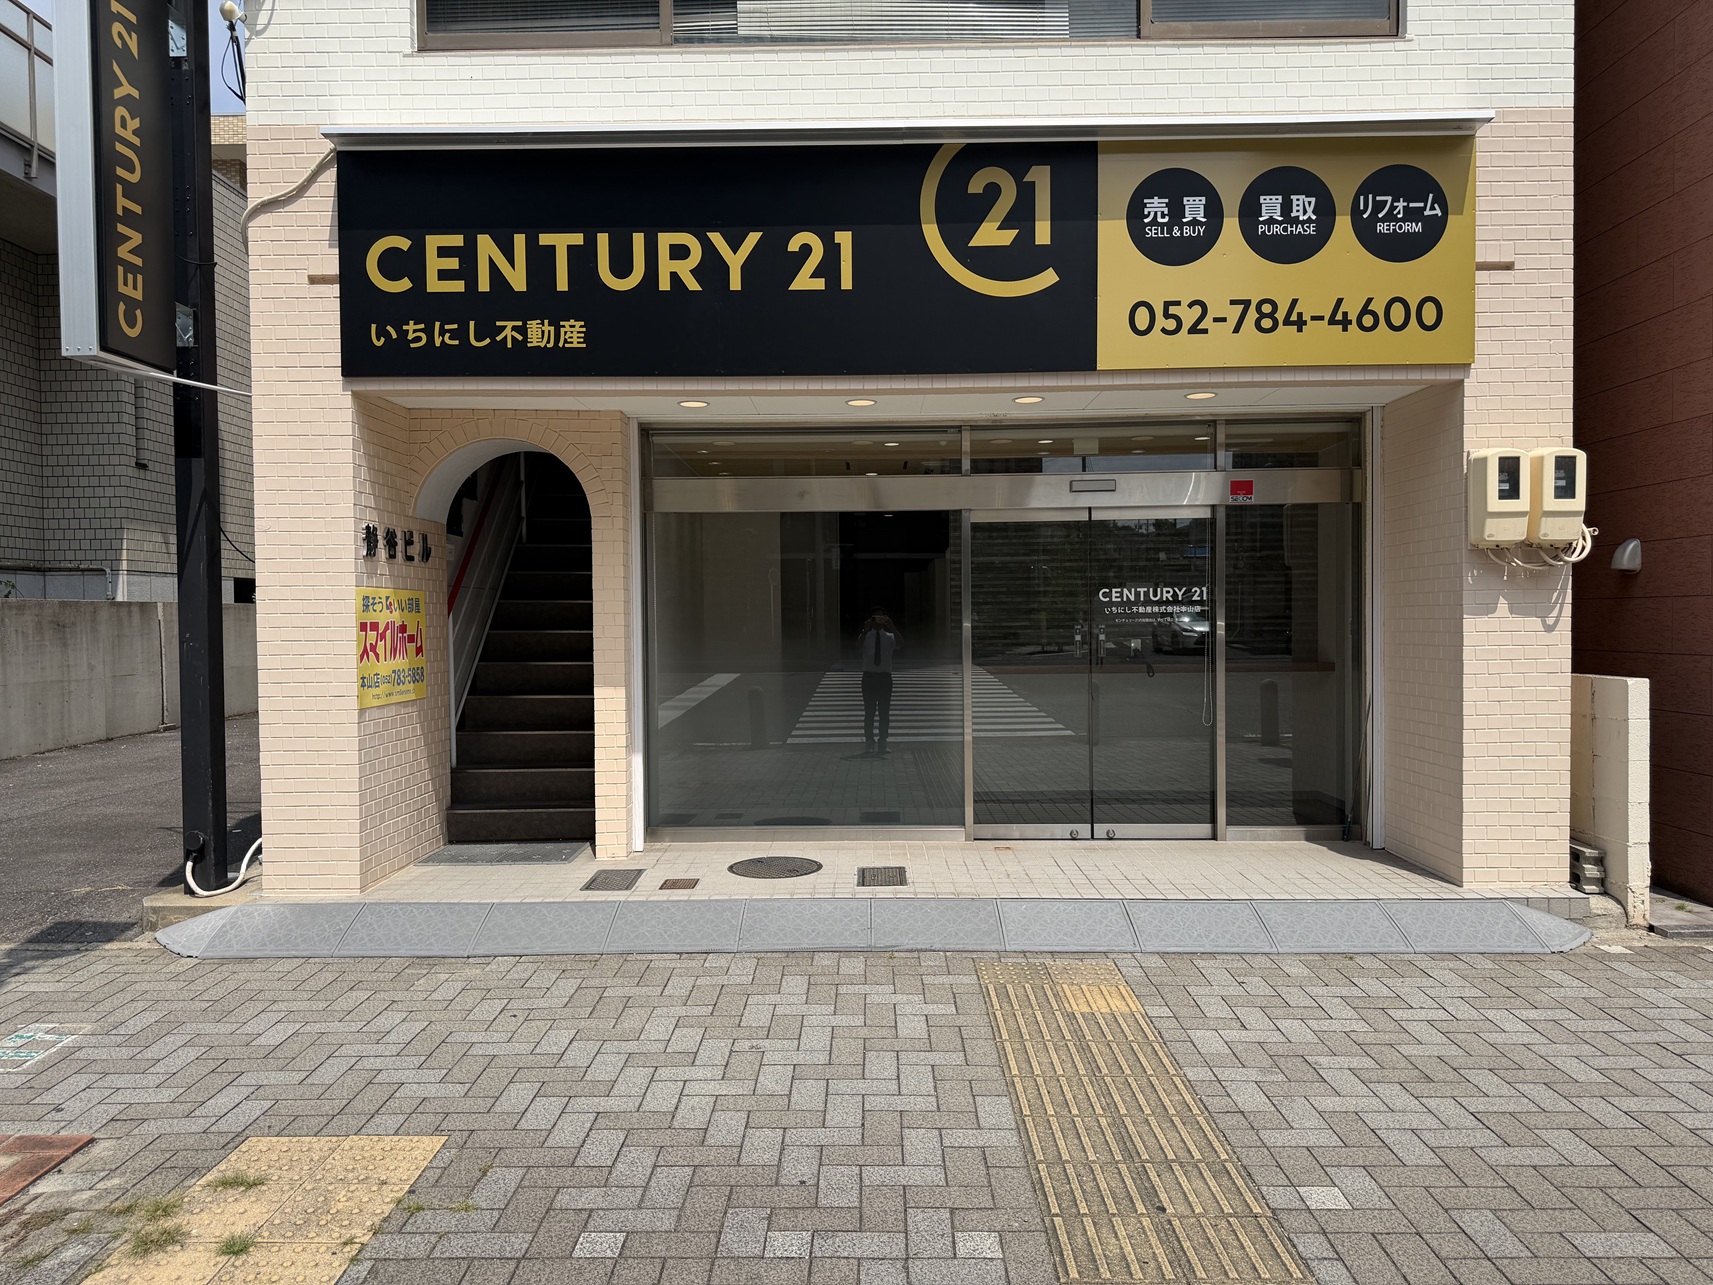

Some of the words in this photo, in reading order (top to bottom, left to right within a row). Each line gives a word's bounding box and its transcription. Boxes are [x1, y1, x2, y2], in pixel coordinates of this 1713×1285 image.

[110, 0, 139, 61] 21
[111, 59, 144, 338] CENTURY
[1258, 194, 1317, 222] 買取
[1358, 193, 1443, 219] リフォーム
[1145, 226, 1170, 238] SELL
[1172, 226, 1181, 237] &
[1183, 225, 1206, 237] BUY
[1258, 223, 1317, 236] PURCHASE
[1376, 222, 1423, 234] REFORM
[364, 231, 763, 294] CENTURY
[786, 230, 853, 291] 21
[1128, 295, 1444, 337] 052-784-4600
[370, 319, 588, 349] いちにし不動産
[1098, 586, 1187, 602] CENTURY
[1191, 586, 1207, 601] 21
[1104, 605, 1202, 614] いちにし不動産株式会社本山店
[359, 619, 424, 665] スマイルホーム
